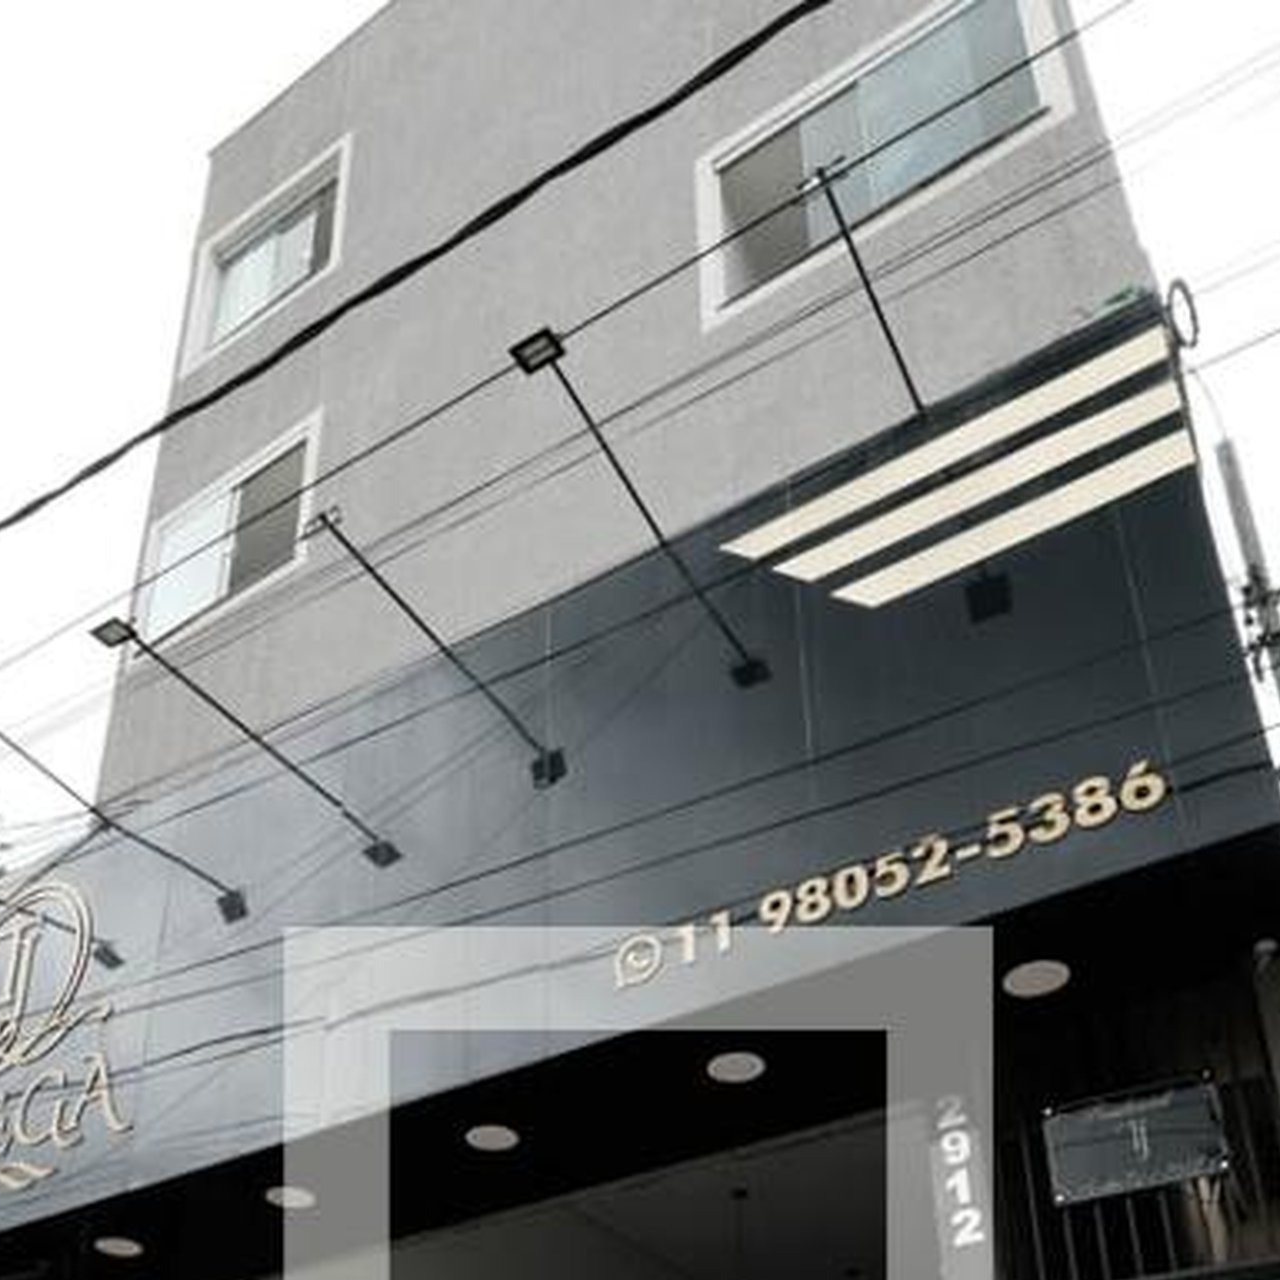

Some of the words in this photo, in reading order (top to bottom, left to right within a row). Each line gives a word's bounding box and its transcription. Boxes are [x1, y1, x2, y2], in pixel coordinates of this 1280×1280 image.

[677, 910, 732, 965] 11
[758, 760, 1168, 934] 98052-5386
[936, 1094, 985, 1246] 2912
